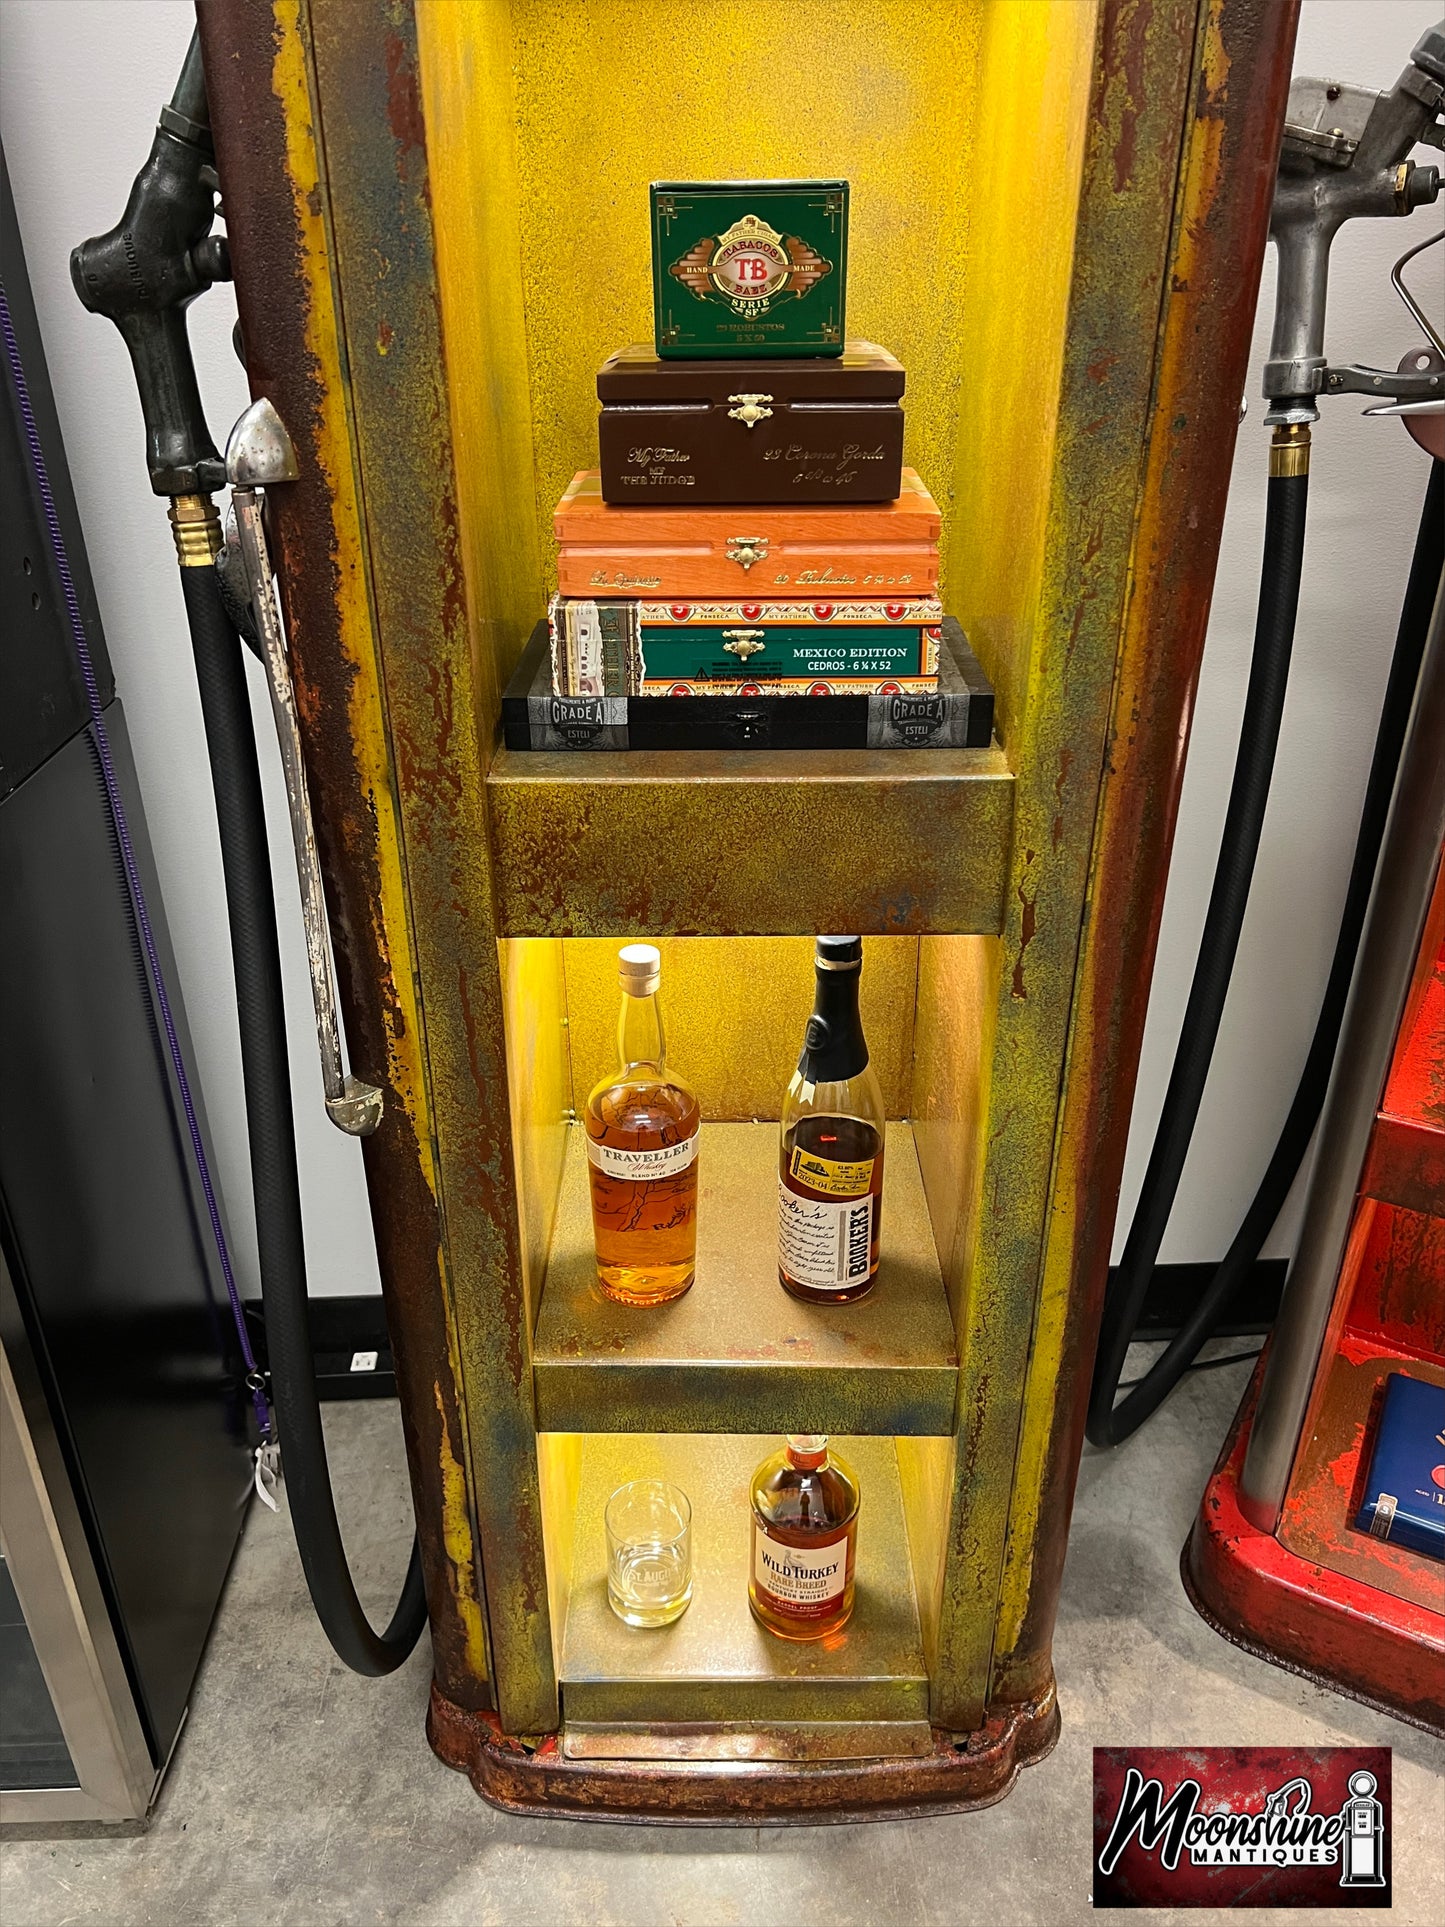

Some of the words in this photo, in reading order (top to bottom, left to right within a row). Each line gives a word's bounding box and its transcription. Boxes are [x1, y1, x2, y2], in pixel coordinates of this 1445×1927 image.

[723, 240, 778, 258] TABACOS
[686, 266, 708, 274] HAND
[734, 258, 768, 281] TB
[793, 264, 815, 272] MADE
[731, 298, 770, 309] SERIE
[745, 308, 759, 316] SF
[627, 447, 654, 468] My
[652, 447, 690, 462] Father
[836, 443, 885, 471] Gorda
[620, 475, 648, 486] THE
[650, 475, 696, 486] JUDGE
[793, 648, 847, 658] MEXICO
[849, 648, 908, 658] EDITION
[807, 661, 845, 671] CEDROS
[853, 661, 859, 670] 6
[870, 661, 878, 670] X
[879, 661, 892, 670] 52
[552, 701, 593, 723] GRADE
[595, 701, 603, 725] A
[893, 699, 933, 720] GRADE
[936, 699, 943, 721] A
[567, 729, 590, 739] ESTELI
[905, 726, 929, 735] ESTELI
[603, 1142, 689, 1162] TRAVELLER
[798, 1173, 828, 1190] 2023-04
[848, 1205, 869, 1278] BOOKER'S
[762, 1550, 791, 1577] WILD
[792, 1562, 839, 1580] TURKEY
[769, 1580, 797, 1593] KENTUCKY
[770, 1571, 794, 1587] RARE
[795, 1580, 827, 1589] BREED
[767, 1583, 797, 1599] BOURBON
[799, 1591, 829, 1600] WHISKEY
[777, 1600, 797, 1609] BARREL
